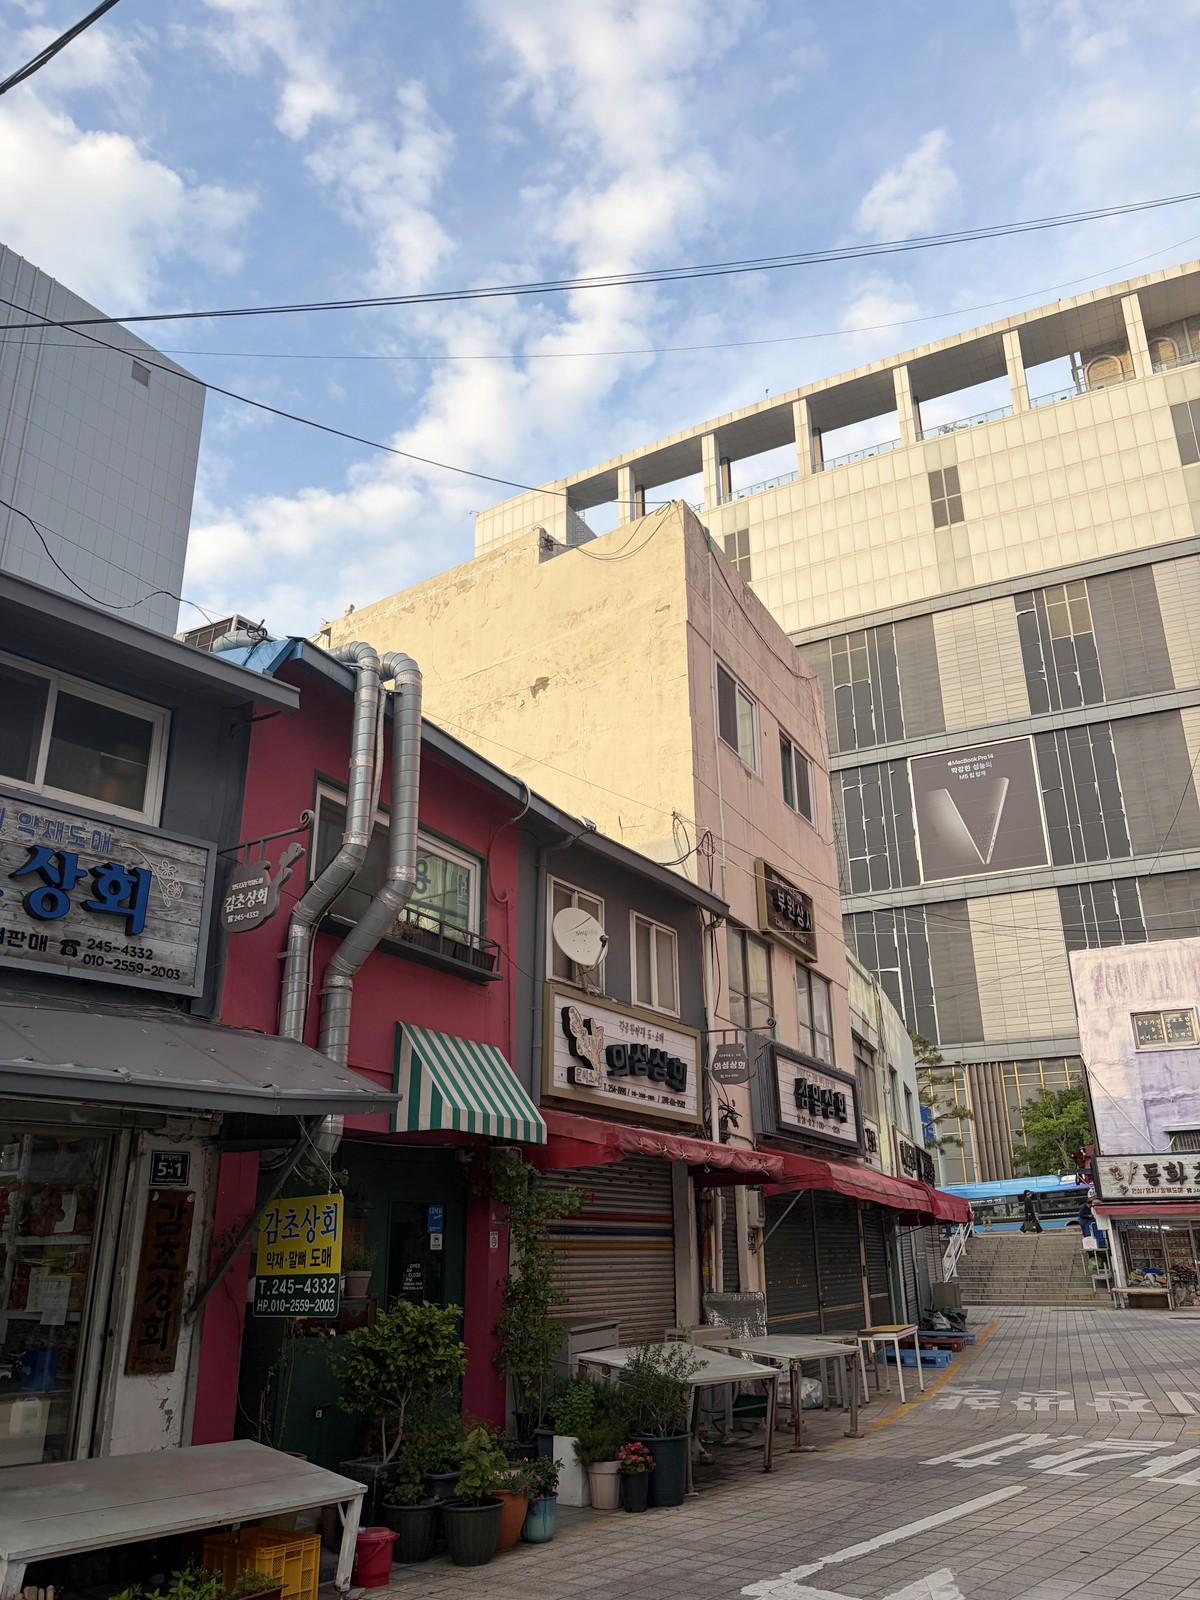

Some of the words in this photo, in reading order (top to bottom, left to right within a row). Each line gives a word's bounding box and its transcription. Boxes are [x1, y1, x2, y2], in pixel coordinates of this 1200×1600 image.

[951, 757, 977, 765] MacBook
[17, 812, 112, 854] 약재도매
[224, 886, 269, 913] 감초상회
[87, 937, 154, 961] 245-4332
[82, 952, 181, 981] 010-2559-2003
[605, 1043, 688, 1093] 의성상회
[713, 1060, 746, 1071] 의성상회
[157, 1162, 182, 1177] 5-1
[263, 1202, 338, 1246] 감초상회
[309, 1246, 332, 1269] 도매
[138, 1199, 188, 1352] 감초상회
[259, 1277, 336, 1295] T.245-4332
[256, 1298, 335, 1313] HP.010-2559-2003
